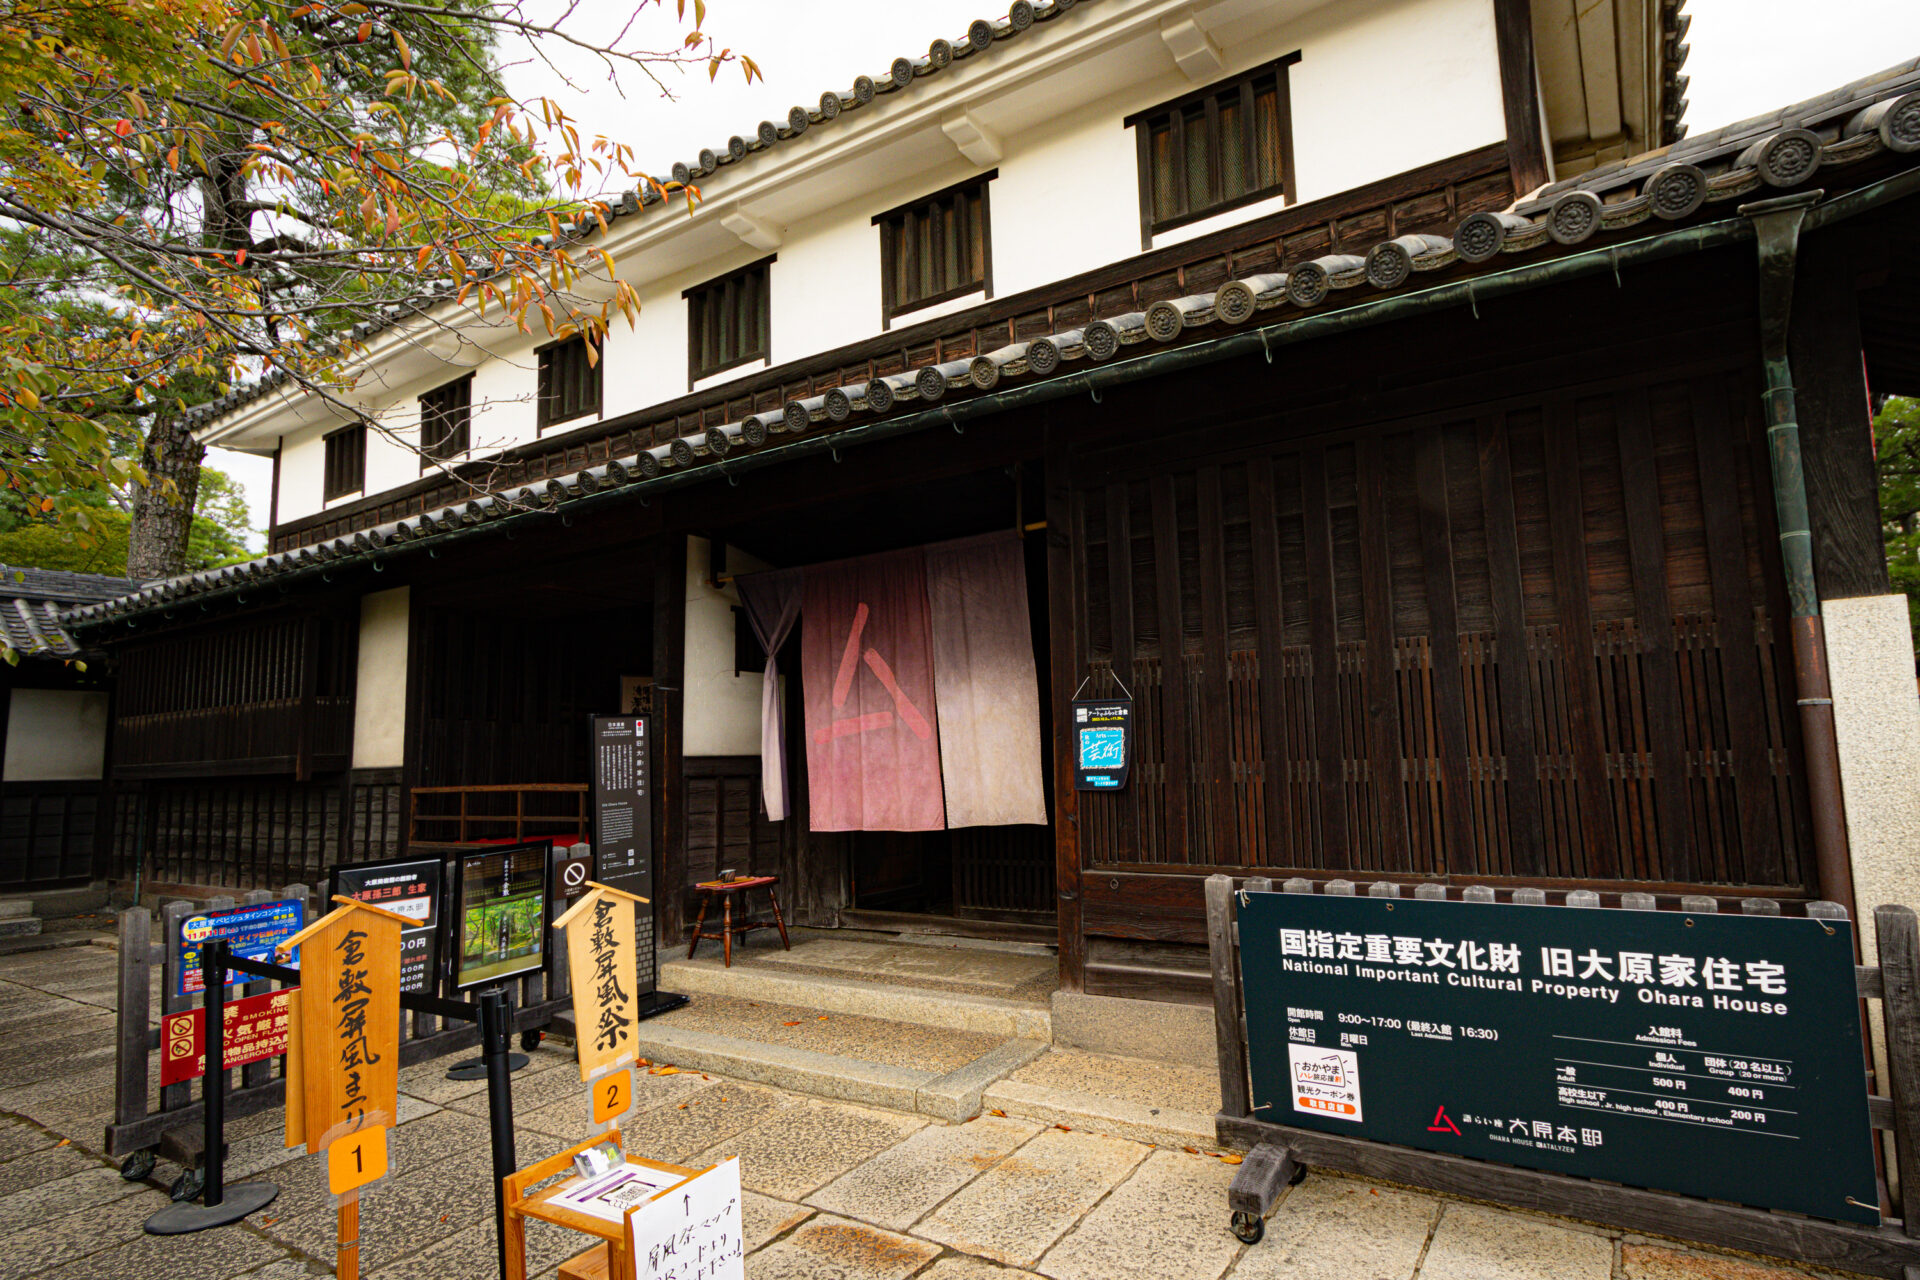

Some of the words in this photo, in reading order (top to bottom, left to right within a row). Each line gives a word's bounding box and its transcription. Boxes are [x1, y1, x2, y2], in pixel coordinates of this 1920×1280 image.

[1280, 928, 1521, 974] 国指定重要文化財
[1541, 946, 1787, 995] 旧大原家住宅
[584, 898, 632, 1051] 倉敷屏風祭
[1282, 959, 1349, 976] National
[1356, 964, 1440, 984] Important
[1447, 973, 1523, 992] Cultural
[1531, 979, 1620, 1003] Property
[1637, 988, 1704, 1008] Ohara
[1713, 995, 1788, 1015] House
[1287, 1007, 1324, 1021] 開館時間
[234, 1033, 259, 1044] OPEN
[1289, 1026, 1316, 1039] 休館日
[1340, 1032, 1368, 1046] 月曜日
[1648, 1026, 1682, 1038] 入館料
[1635, 1034, 1676, 1045] Admission
[1677, 1038, 1697, 1047] Fees
[224, 1047, 274, 1065] ANGEROUS
[1655, 1052, 1677, 1064] 個人
[1302, 1061, 1340, 1075] おかやま
[1556, 1066, 1577, 1077] 一般
[1648, 1061, 1686, 1071] Individual
[1709, 1067, 1735, 1077] Group
[607, 1084, 619, 1109] 2
[1297, 1084, 1355, 1101] 観光クーポン券
[1558, 1086, 1607, 1101] 高校生以下
[1558, 1096, 1575, 1104] High
[1615, 1103, 1632, 1112] high
[1663, 1108, 1705, 1122] Elementary
[1706, 1116, 1733, 1125] school
[1509, 1117, 1603, 1147] 大原本邸
[1489, 1133, 1510, 1143] OHARA
[1512, 1137, 1533, 1147] HOUSE
[351, 1144, 363, 1174] 1
